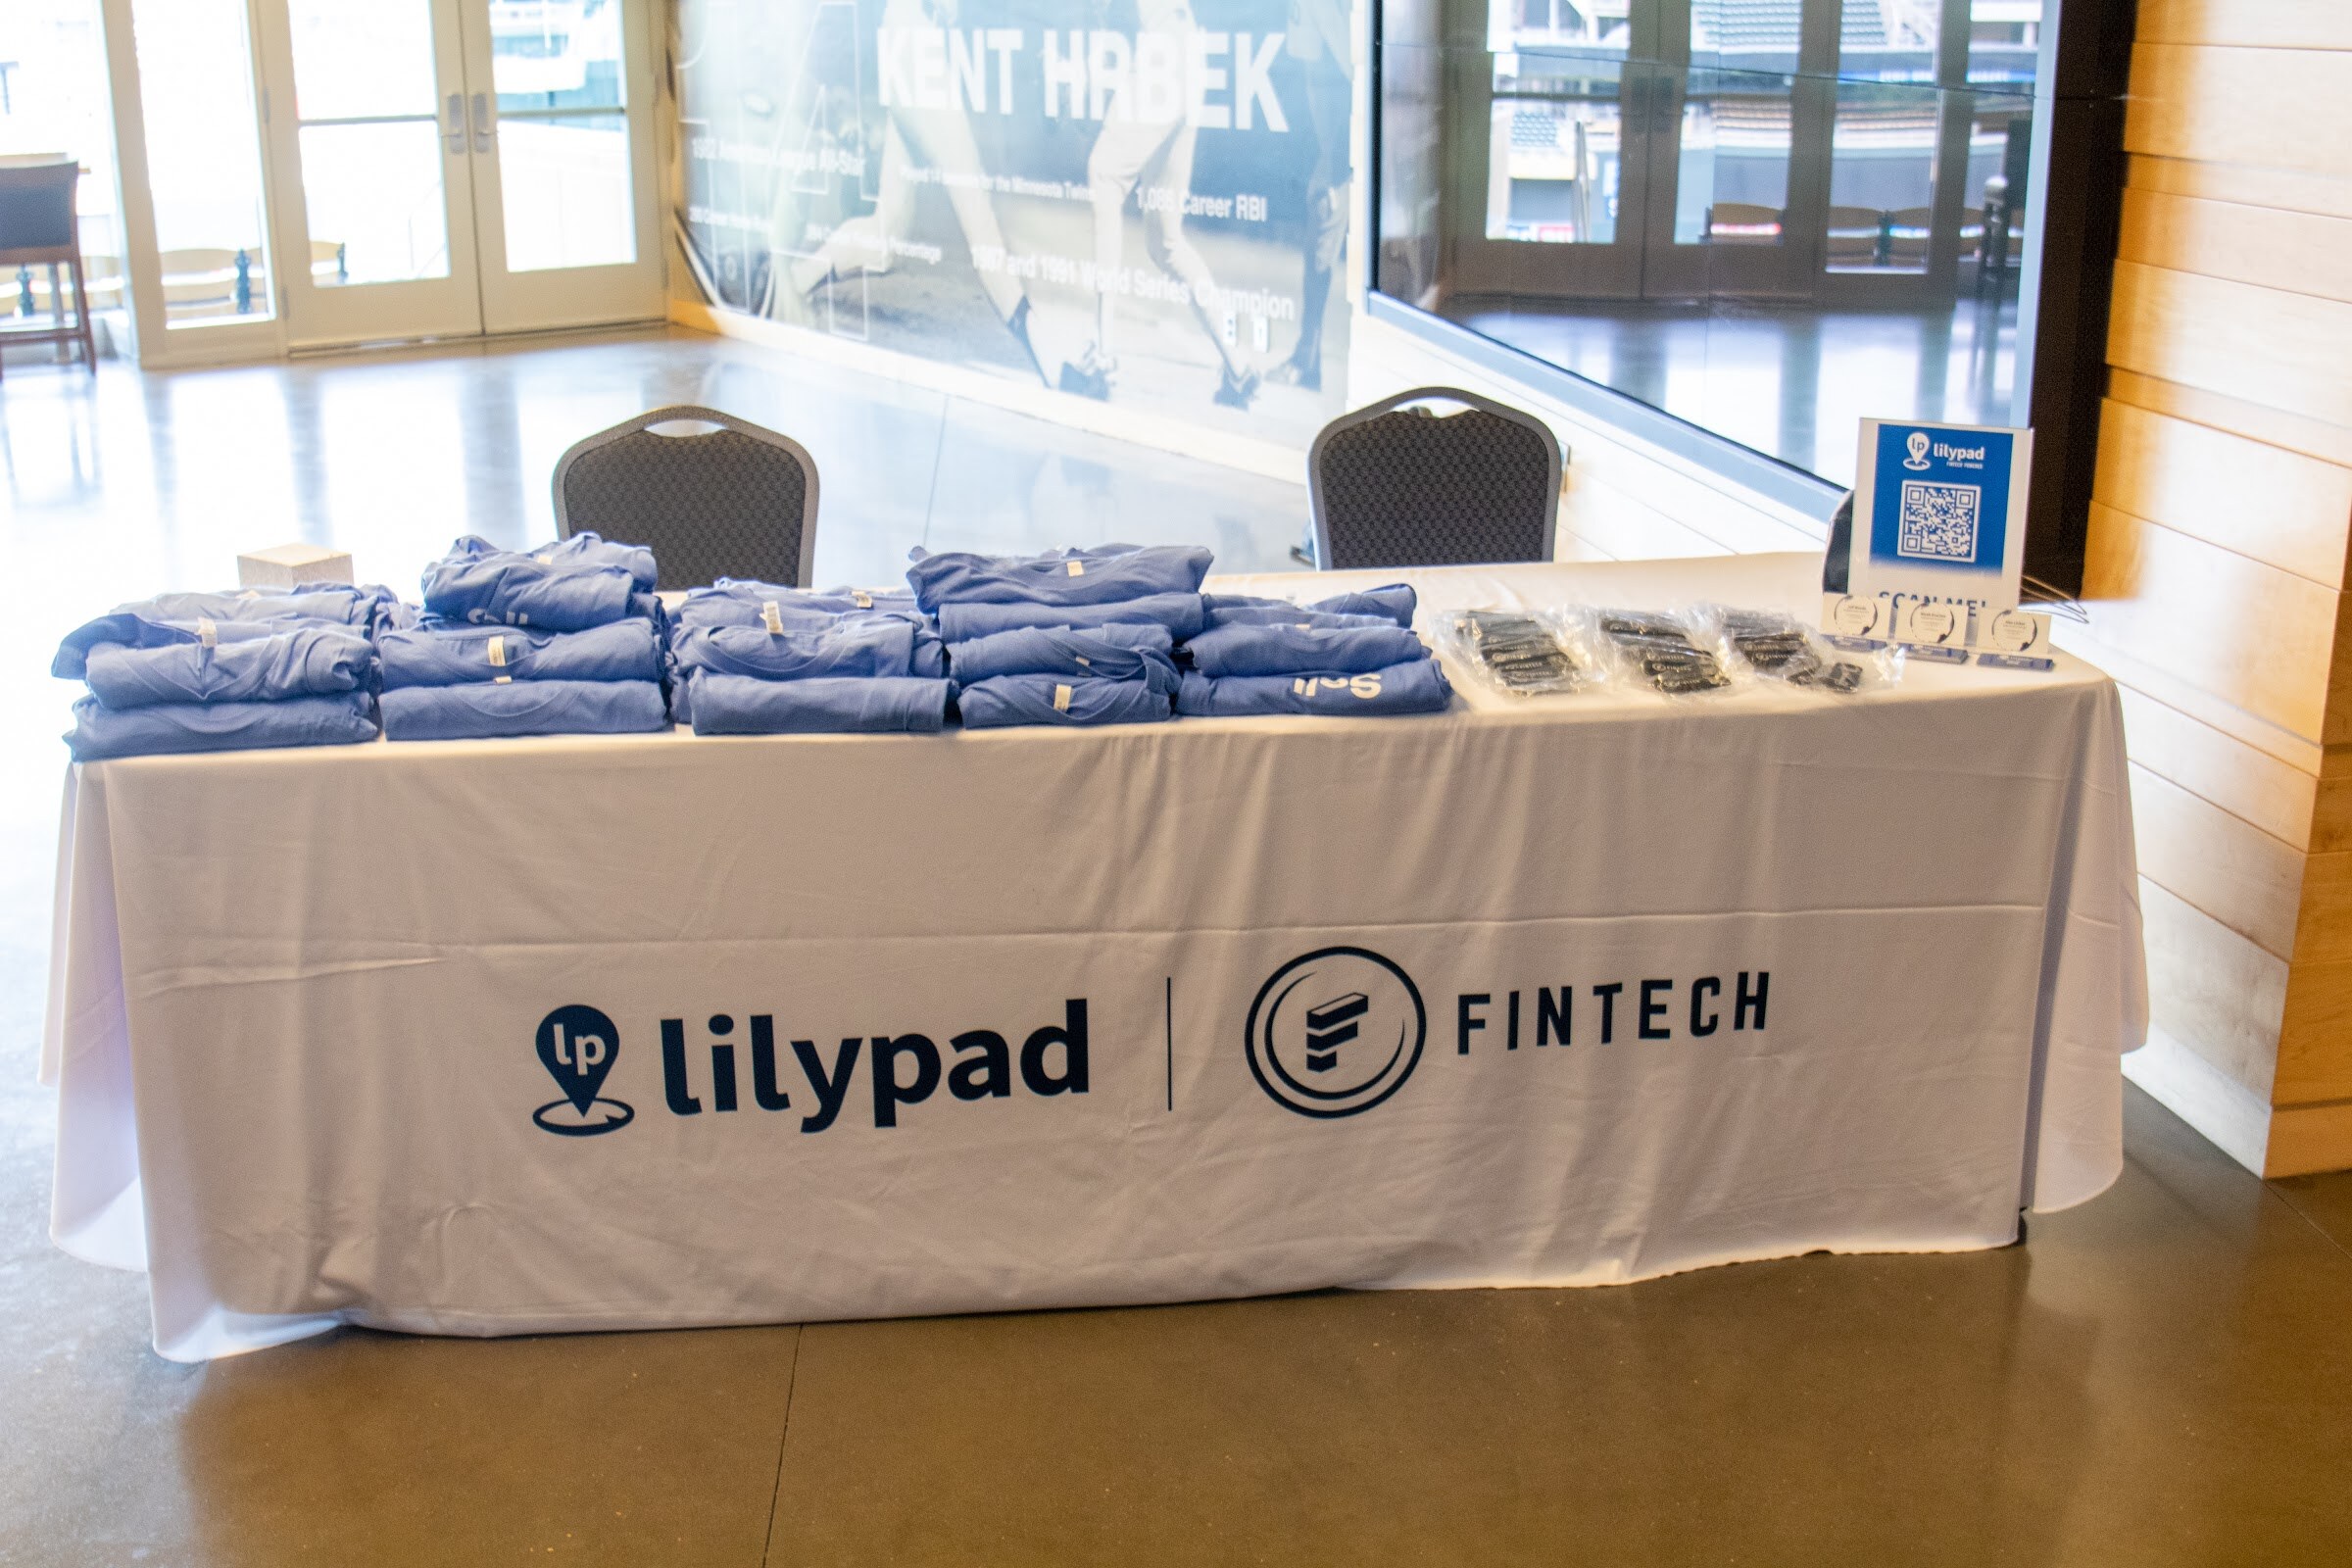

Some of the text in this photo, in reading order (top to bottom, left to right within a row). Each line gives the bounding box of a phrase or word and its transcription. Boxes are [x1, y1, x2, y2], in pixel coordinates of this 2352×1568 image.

[876, 27, 1290, 133] KENT HRBEK
[1180, 191, 1234, 219] Career
[1236, 194, 1268, 222] RBI
[1006, 252, 1036, 279] and
[1041, 255, 1076, 286] 1991
[1079, 260, 1133, 295] World
[1134, 268, 1192, 306] Series
[1194, 278, 1295, 322] Champion
[1911, 437, 1926, 453] lp
[1933, 443, 1985, 462] lilypad
[1456, 970, 1770, 1056] FINTECH
[552, 1022, 608, 1076] lp
[659, 997, 1090, 1134] lilypad
